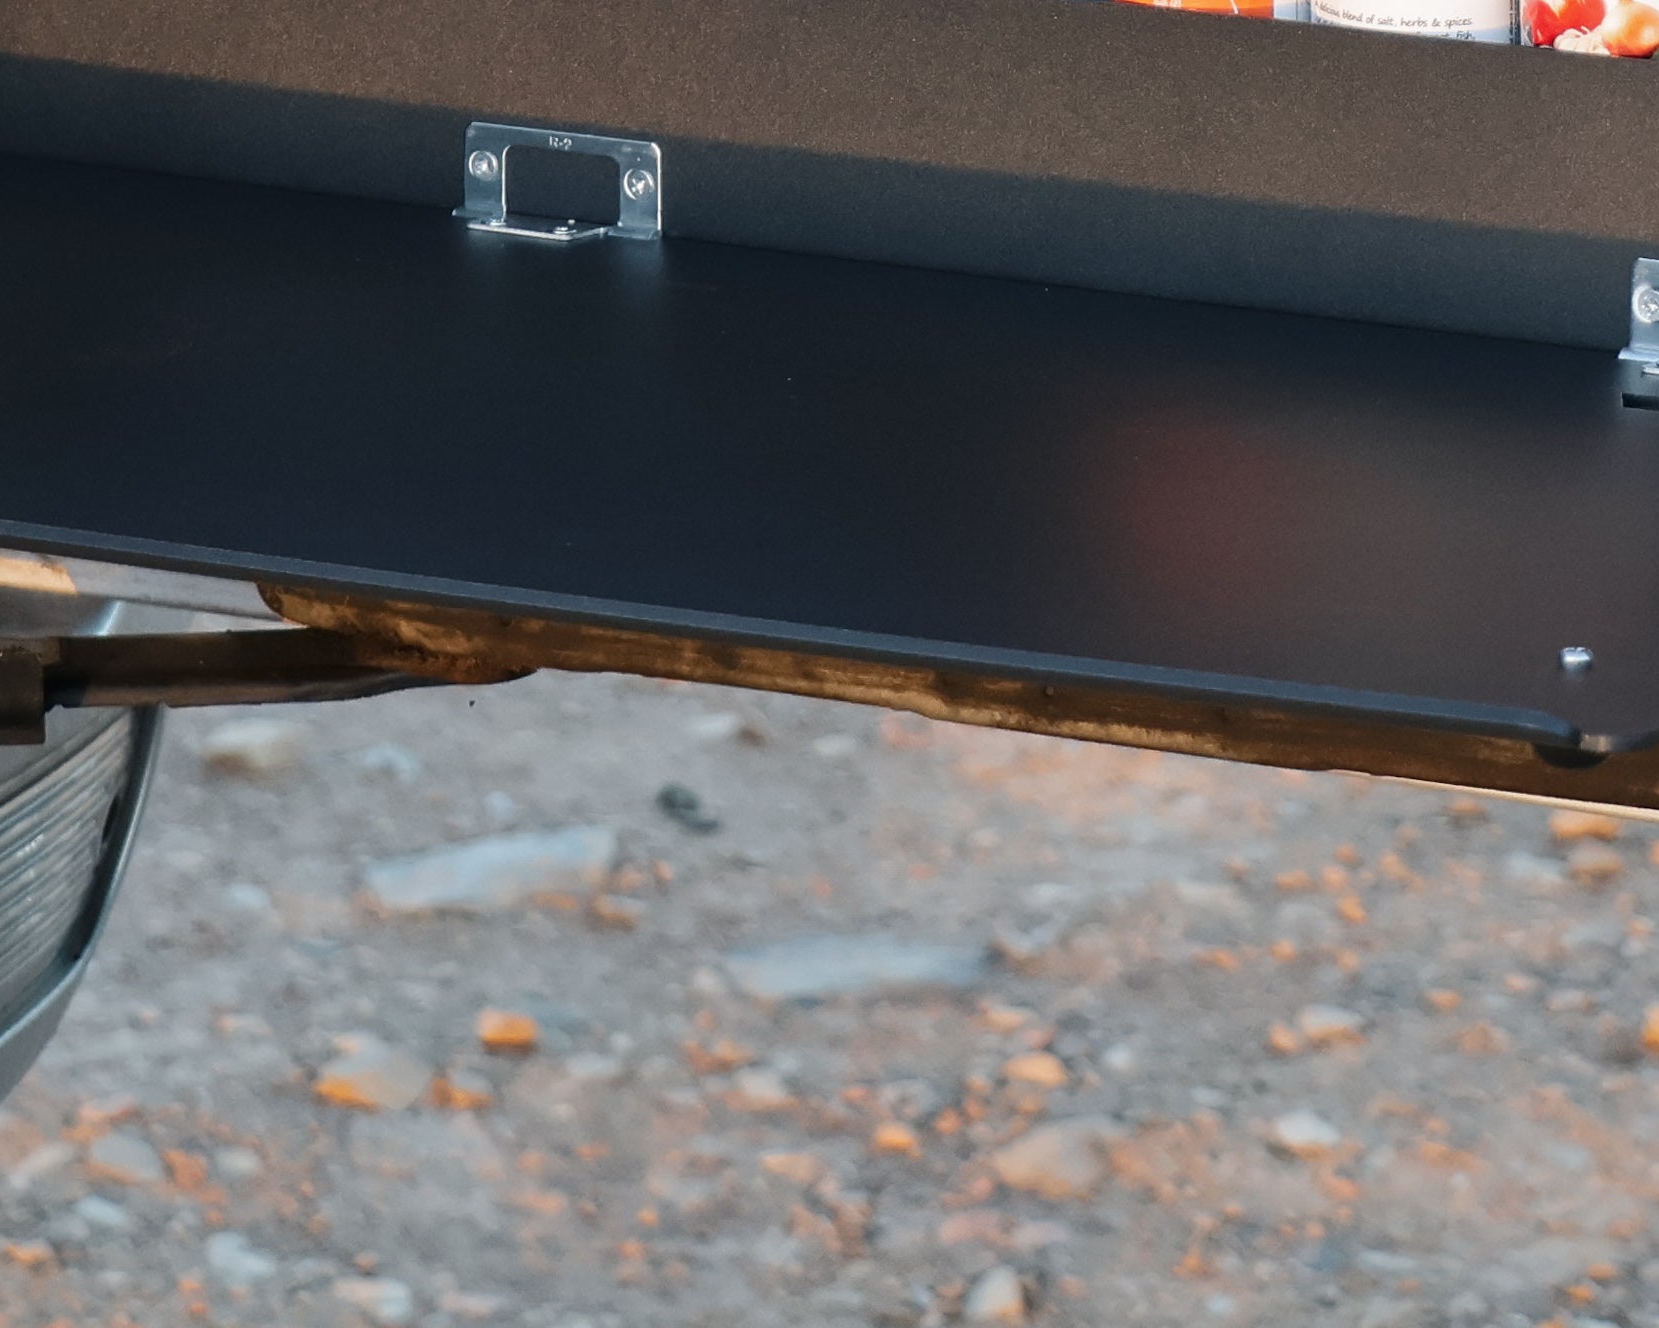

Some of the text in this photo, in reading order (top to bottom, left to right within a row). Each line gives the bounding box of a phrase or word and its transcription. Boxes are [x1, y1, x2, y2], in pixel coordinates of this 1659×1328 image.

[1342, 9, 1363, 22] blend
[1365, 14, 1375, 24] of
[1400, 18, 1427, 27] herbs
[1431, 19, 1441, 27] &
[1445, 17, 1473, 29] spices
